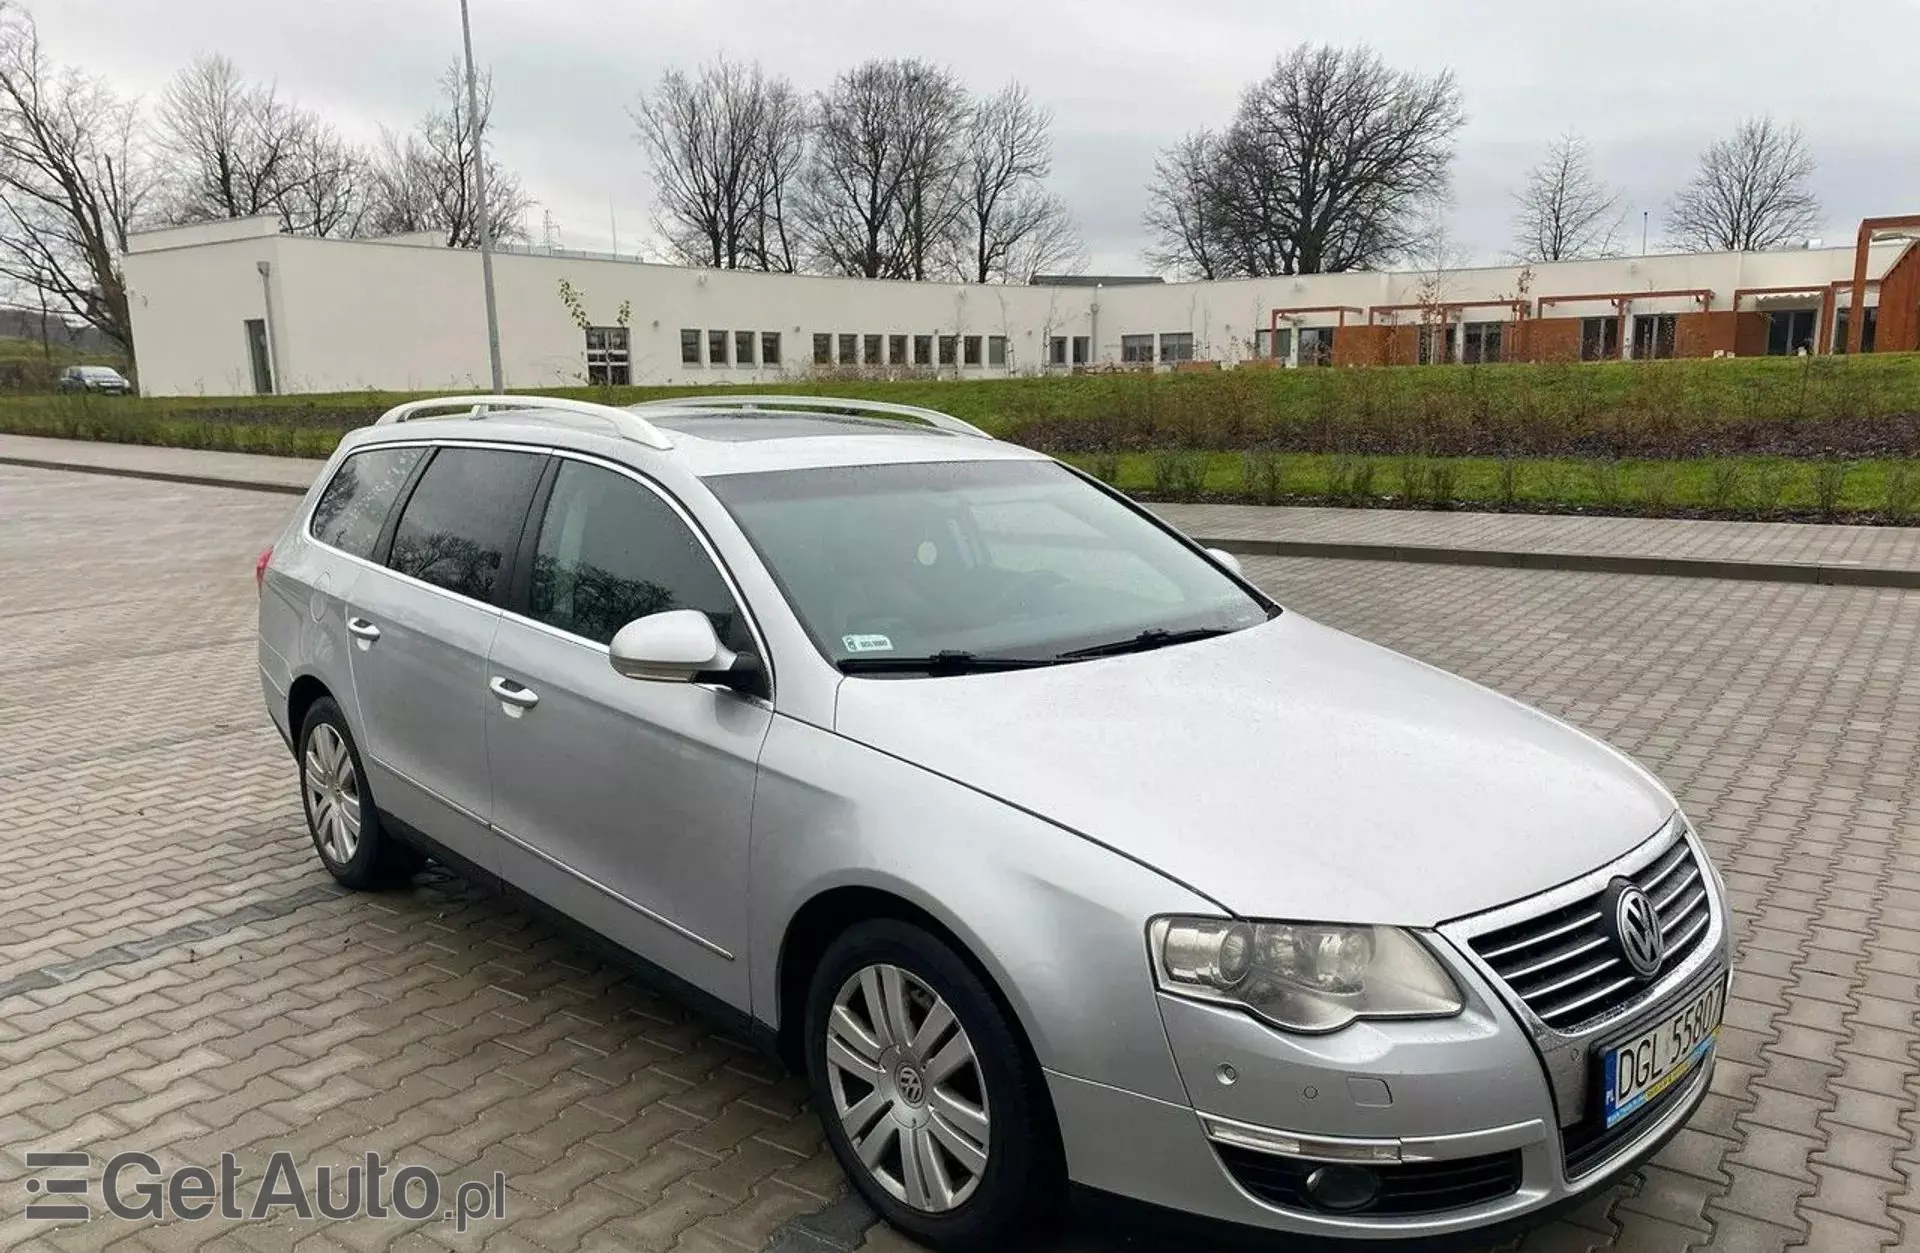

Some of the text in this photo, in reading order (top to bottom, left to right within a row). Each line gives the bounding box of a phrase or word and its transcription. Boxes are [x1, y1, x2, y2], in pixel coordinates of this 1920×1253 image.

[1620, 890, 1661, 970] VW
[1618, 1032, 1662, 1101] DGL
[1670, 981, 1723, 1064] 55807
